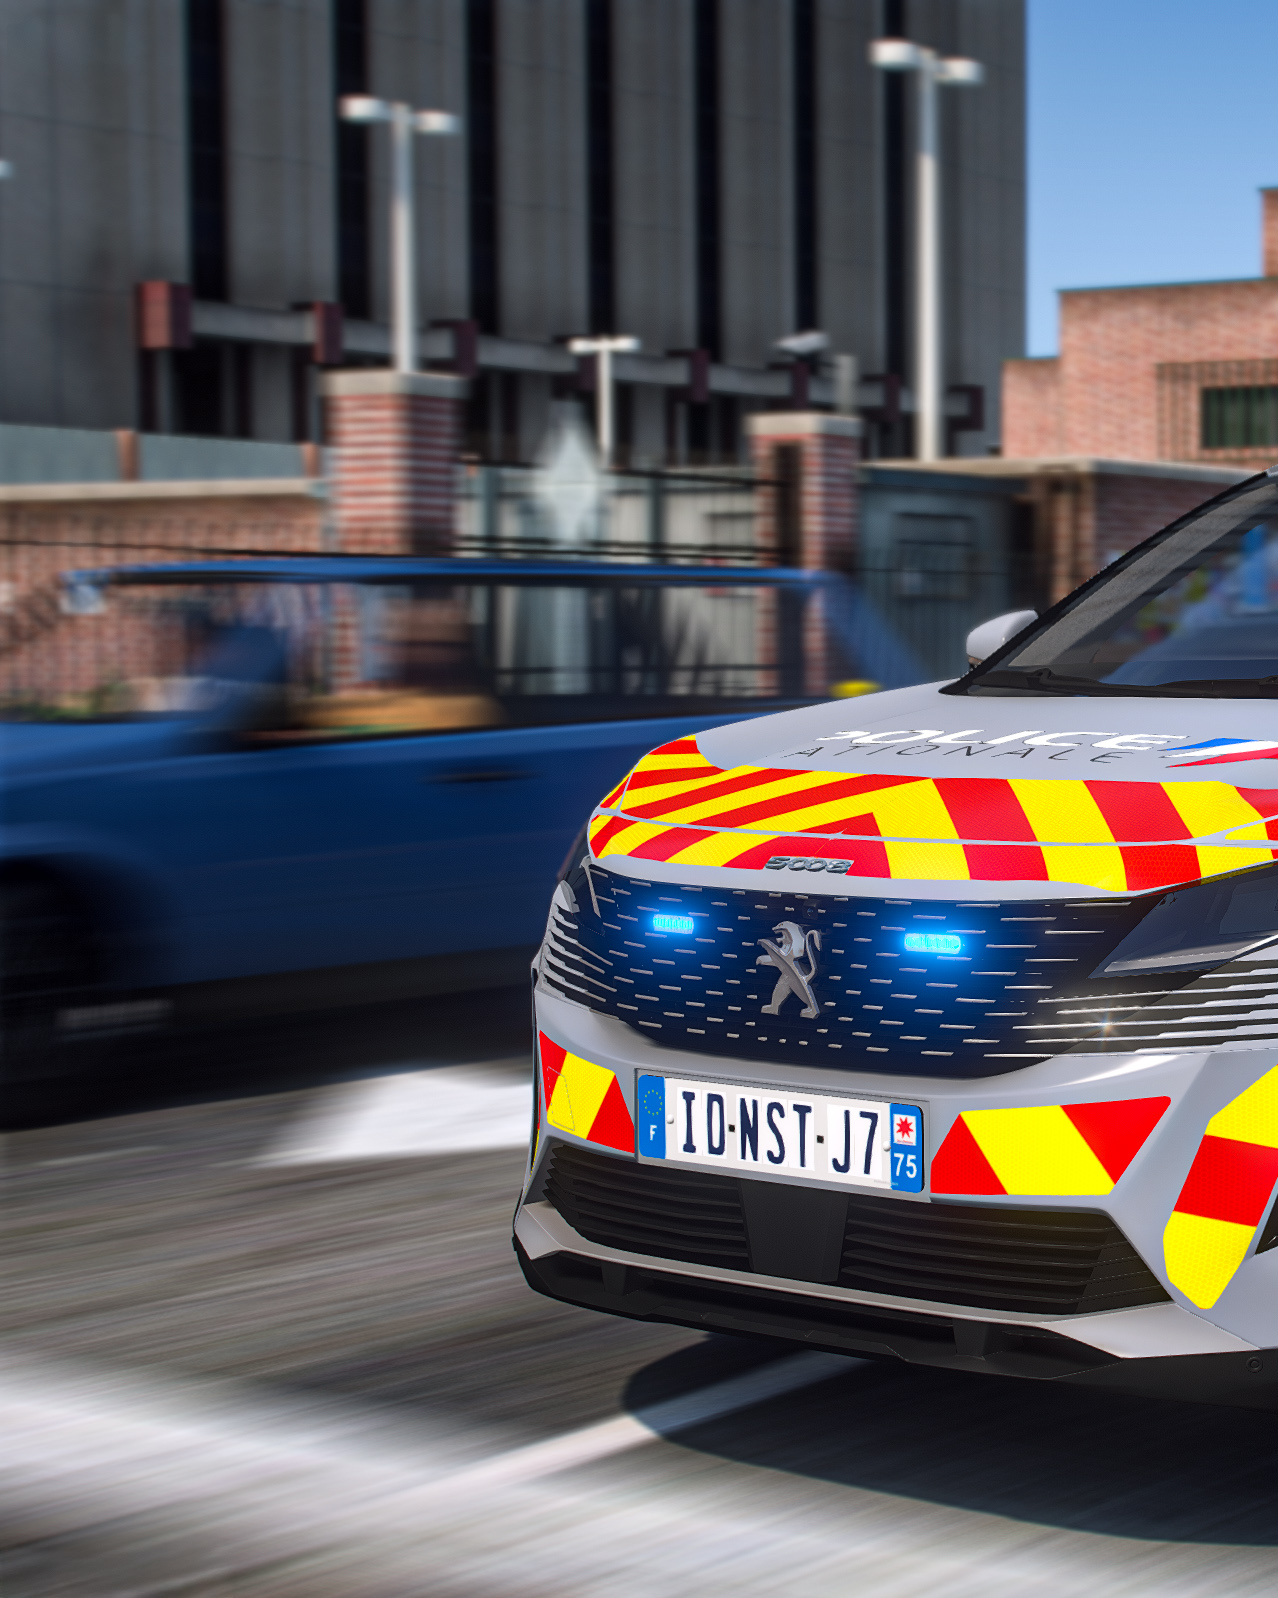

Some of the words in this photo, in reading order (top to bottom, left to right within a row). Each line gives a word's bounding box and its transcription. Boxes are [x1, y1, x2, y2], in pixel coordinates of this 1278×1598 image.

[779, 744, 1134, 764] ATIONALE
[765, 856, 852, 875] 5008
[649, 1124, 659, 1141] F
[893, 1152, 918, 1179] 75
